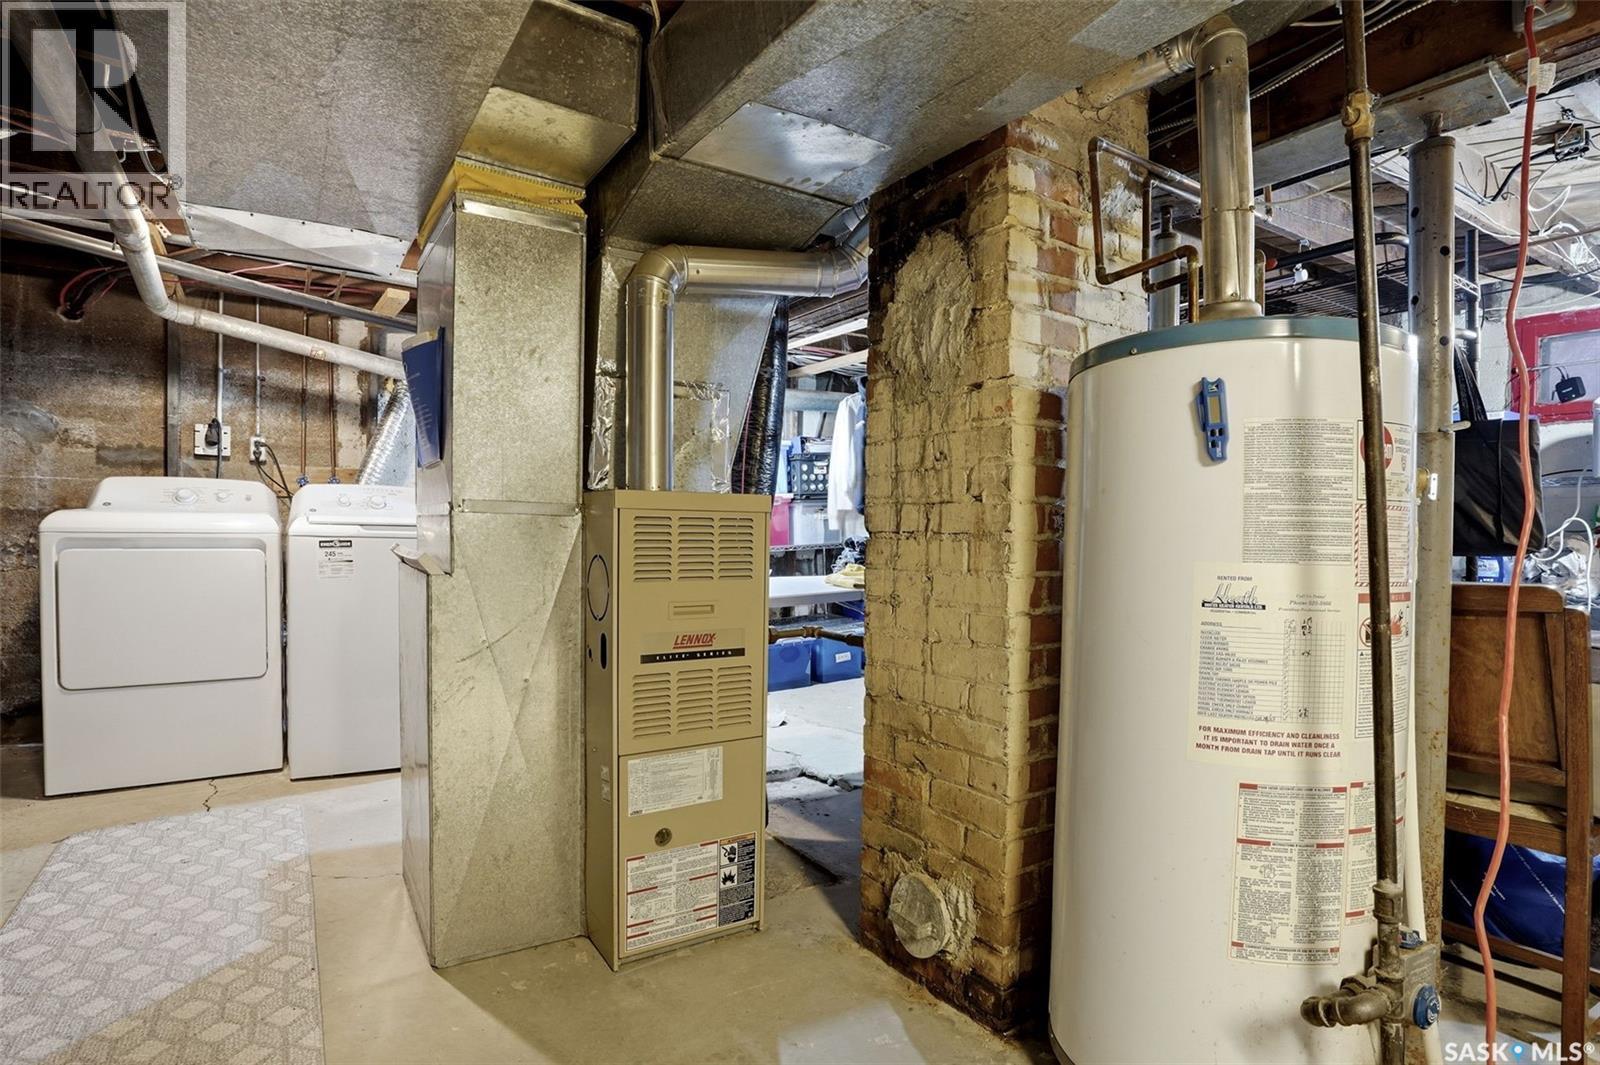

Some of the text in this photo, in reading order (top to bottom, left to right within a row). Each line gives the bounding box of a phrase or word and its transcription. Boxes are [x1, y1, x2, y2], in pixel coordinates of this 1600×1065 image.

[673, 633, 717, 646] LENNOX
[1213, 727, 1246, 735] MAXIMUM
[1248, 730, 1285, 738] EFFICIENCY
[1301, 732, 1340, 740] CLEANLINESS
[1195, 742, 1219, 751] MONTH
[1221, 745, 1240, 753] FROM
[1220, 737, 1257, 746] IMPORTANT
